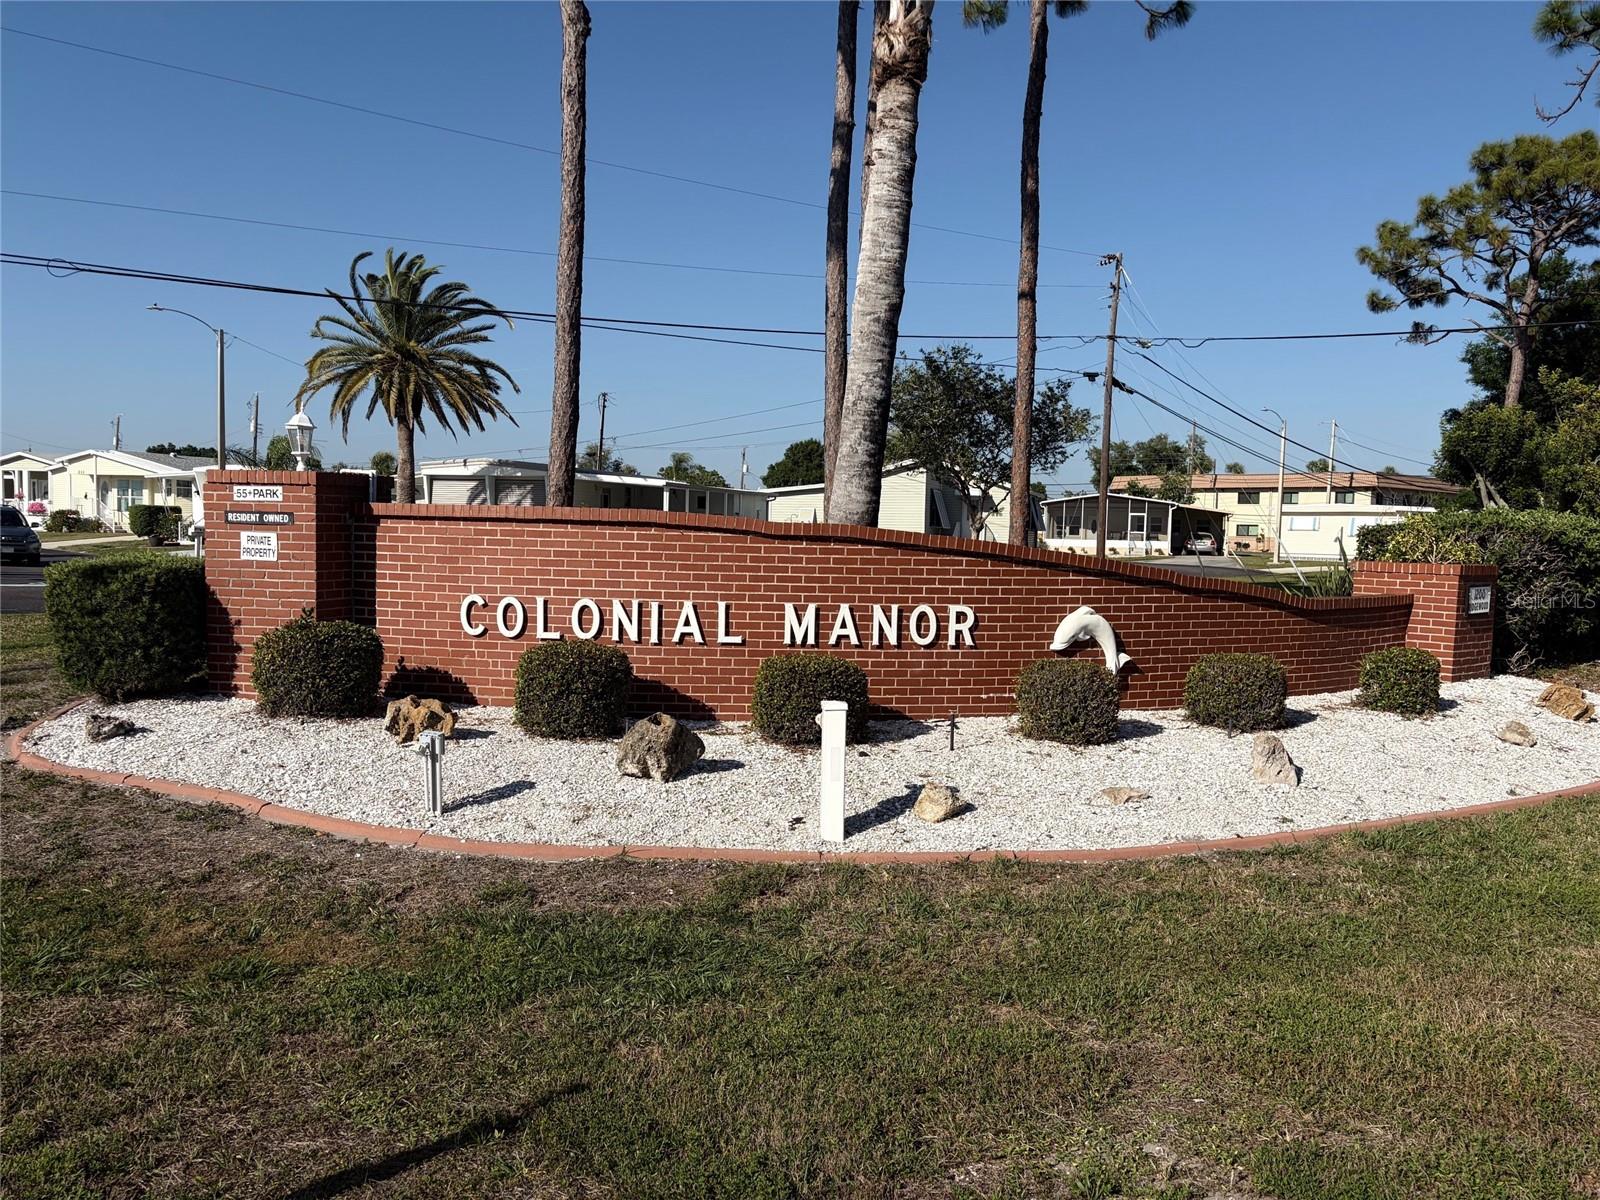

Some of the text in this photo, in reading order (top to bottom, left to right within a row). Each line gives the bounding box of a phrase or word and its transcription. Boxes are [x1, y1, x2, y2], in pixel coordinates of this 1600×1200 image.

[228, 512, 289, 523] RESIDENT OWNED
[246, 535, 272, 546] PRIVATE
[242, 547, 276, 558] PROPERTY
[460, 593, 977, 648] COLONIAL MANOR
